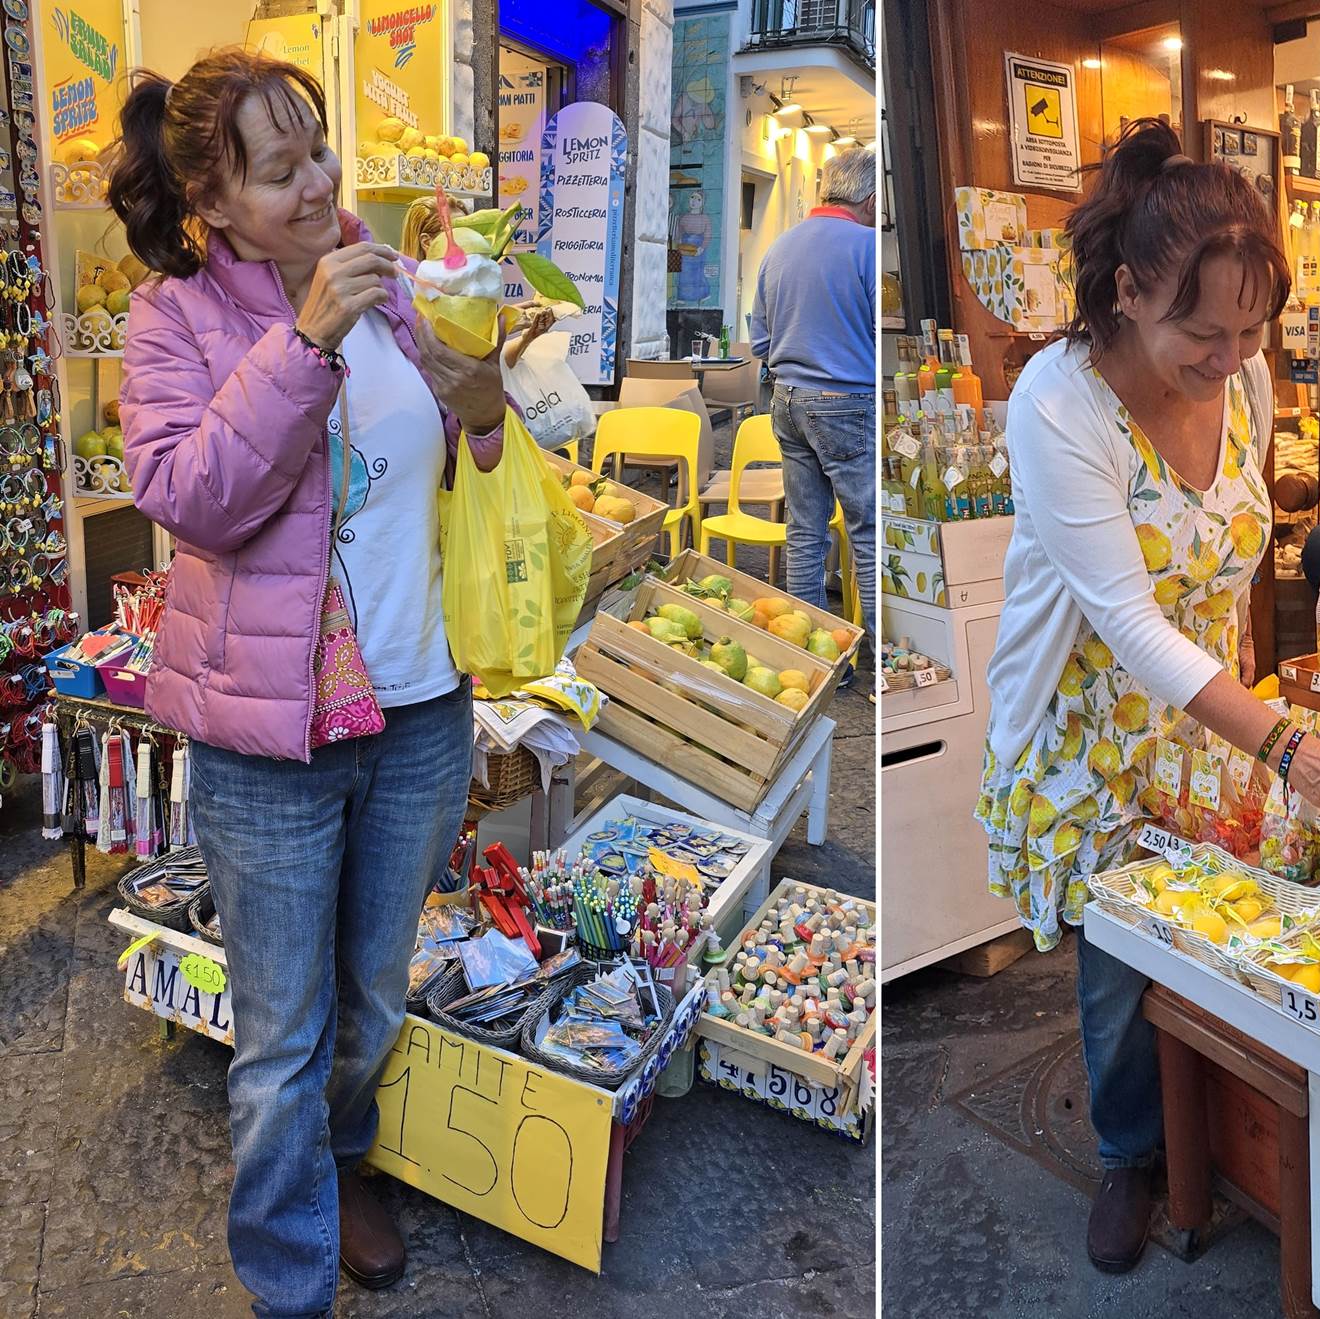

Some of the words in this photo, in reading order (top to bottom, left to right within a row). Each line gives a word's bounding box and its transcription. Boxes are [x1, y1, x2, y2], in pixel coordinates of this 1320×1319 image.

[370, 4, 433, 37] LIMONCELLO
[388, 27, 416, 49] SHOT
[283, 43, 310, 54] Lemon
[1016, 66, 1066, 85] ATTENZIONE!
[52, 77, 96, 113] LEMON
[513, 93, 535, 104] PIATTI
[53, 100, 98, 139] SPRITZ
[563, 136, 609, 155] LEMON
[566, 150, 600, 165] SPRITZ
[556, 174, 608, 186] PIZZETTERIA
[555, 207, 607, 219] ROSTICCERIA
[554, 239, 604, 251] FRIGGITORIA
[564, 271, 604, 283] TRONOMIA
[1285, 326, 1305, 337] VISA
[1143, 831, 1166, 848] 2,50
[1287, 991, 1317, 1021] 1,5
[392, 1025, 543, 1111] AMITE
